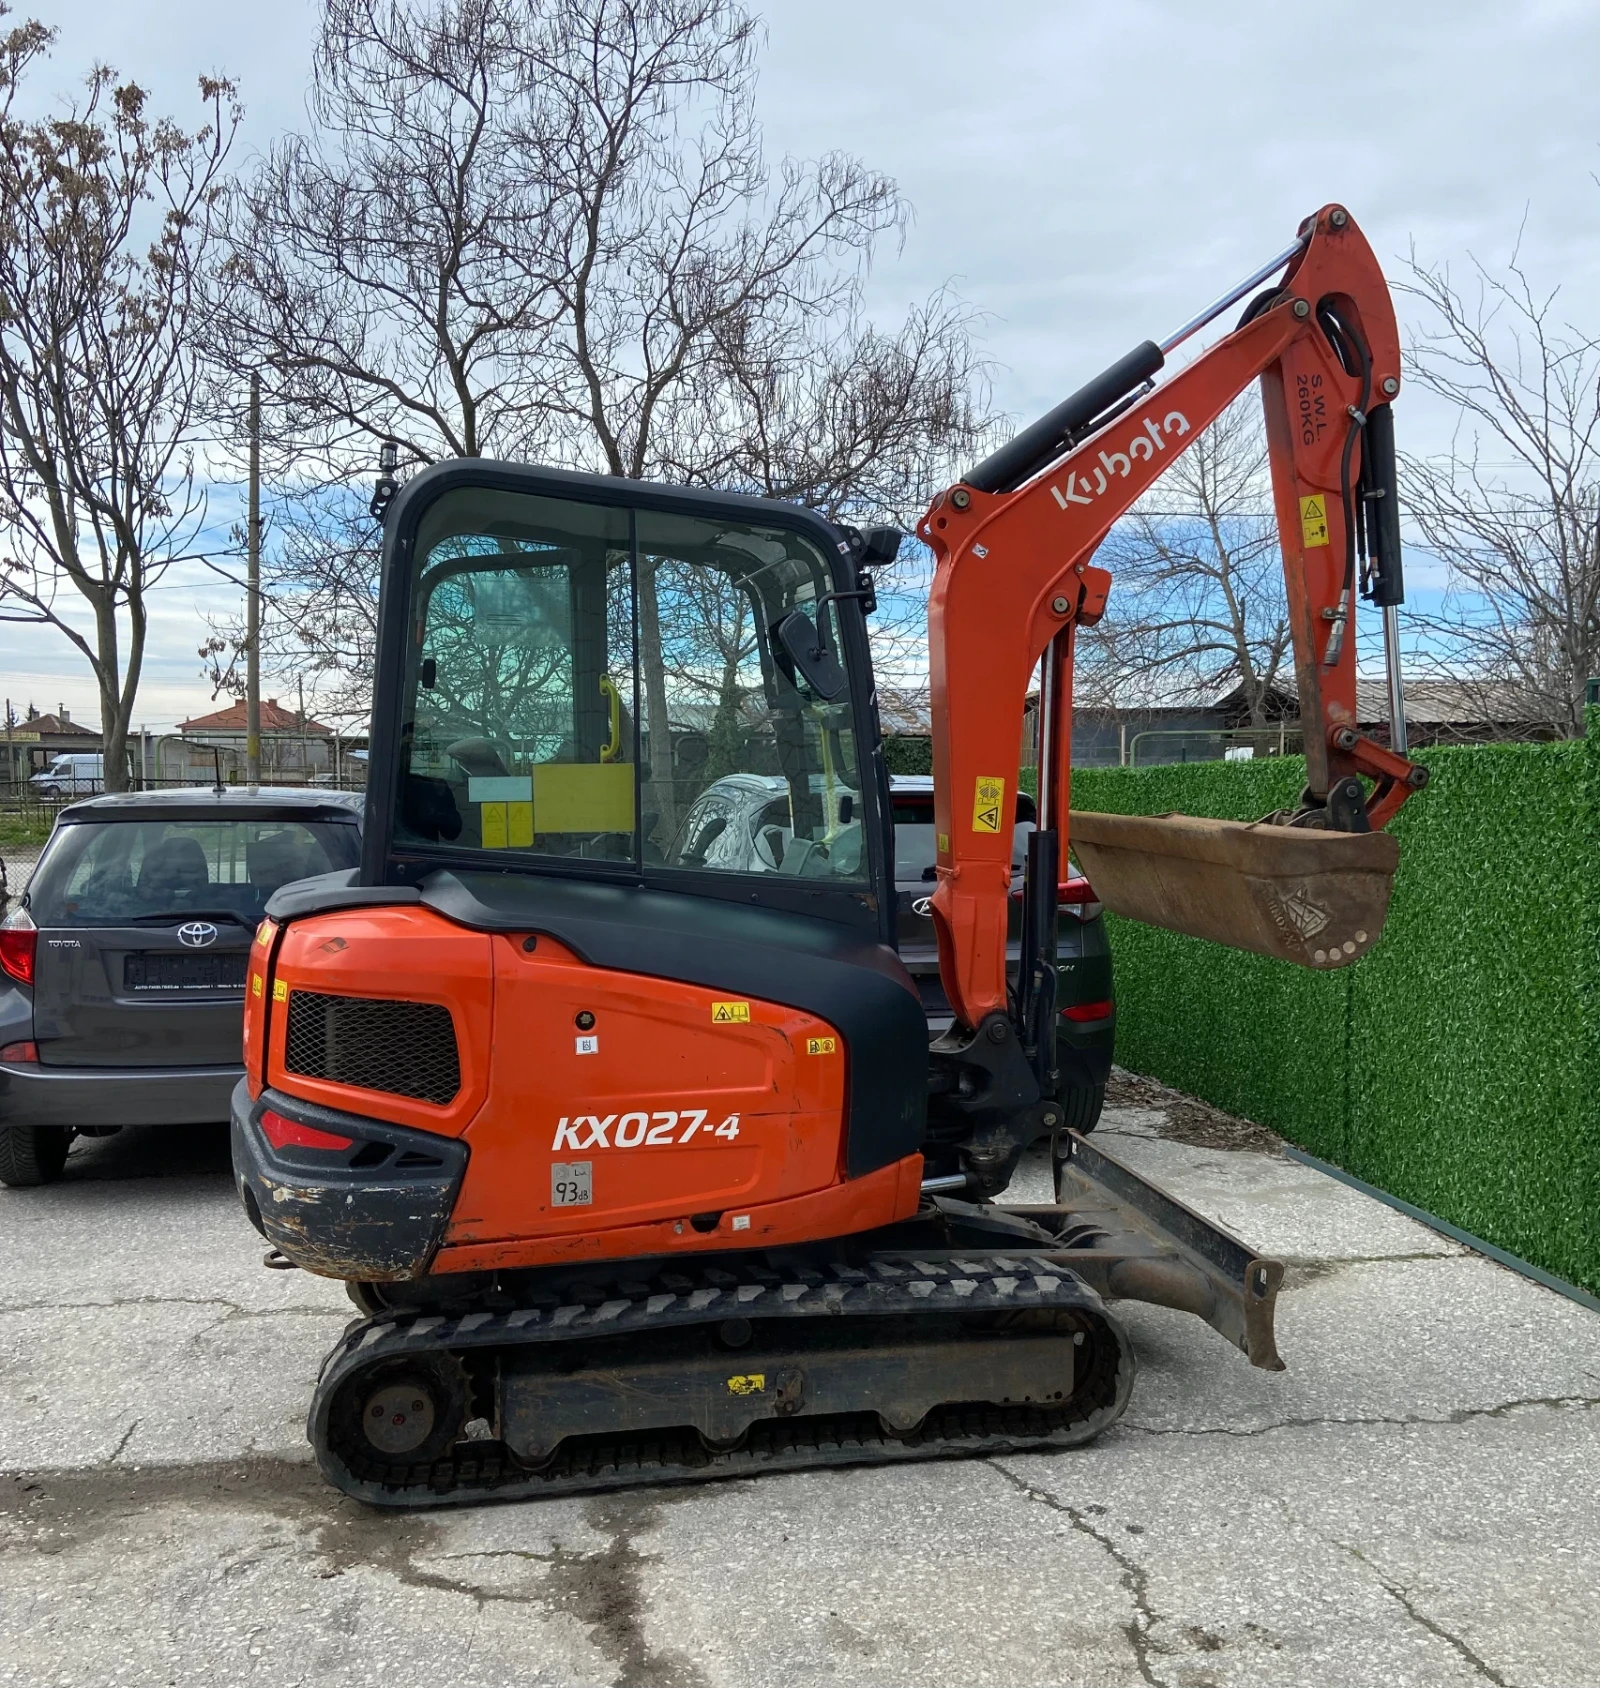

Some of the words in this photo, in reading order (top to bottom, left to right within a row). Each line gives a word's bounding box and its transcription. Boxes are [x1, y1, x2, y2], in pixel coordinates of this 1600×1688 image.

[1296, 373, 1315, 447] 260KG
[1050, 411, 1191, 510] Kubota
[48, 940, 81, 948] TOYOTA
[552, 1109, 740, 1151] KX027-4
